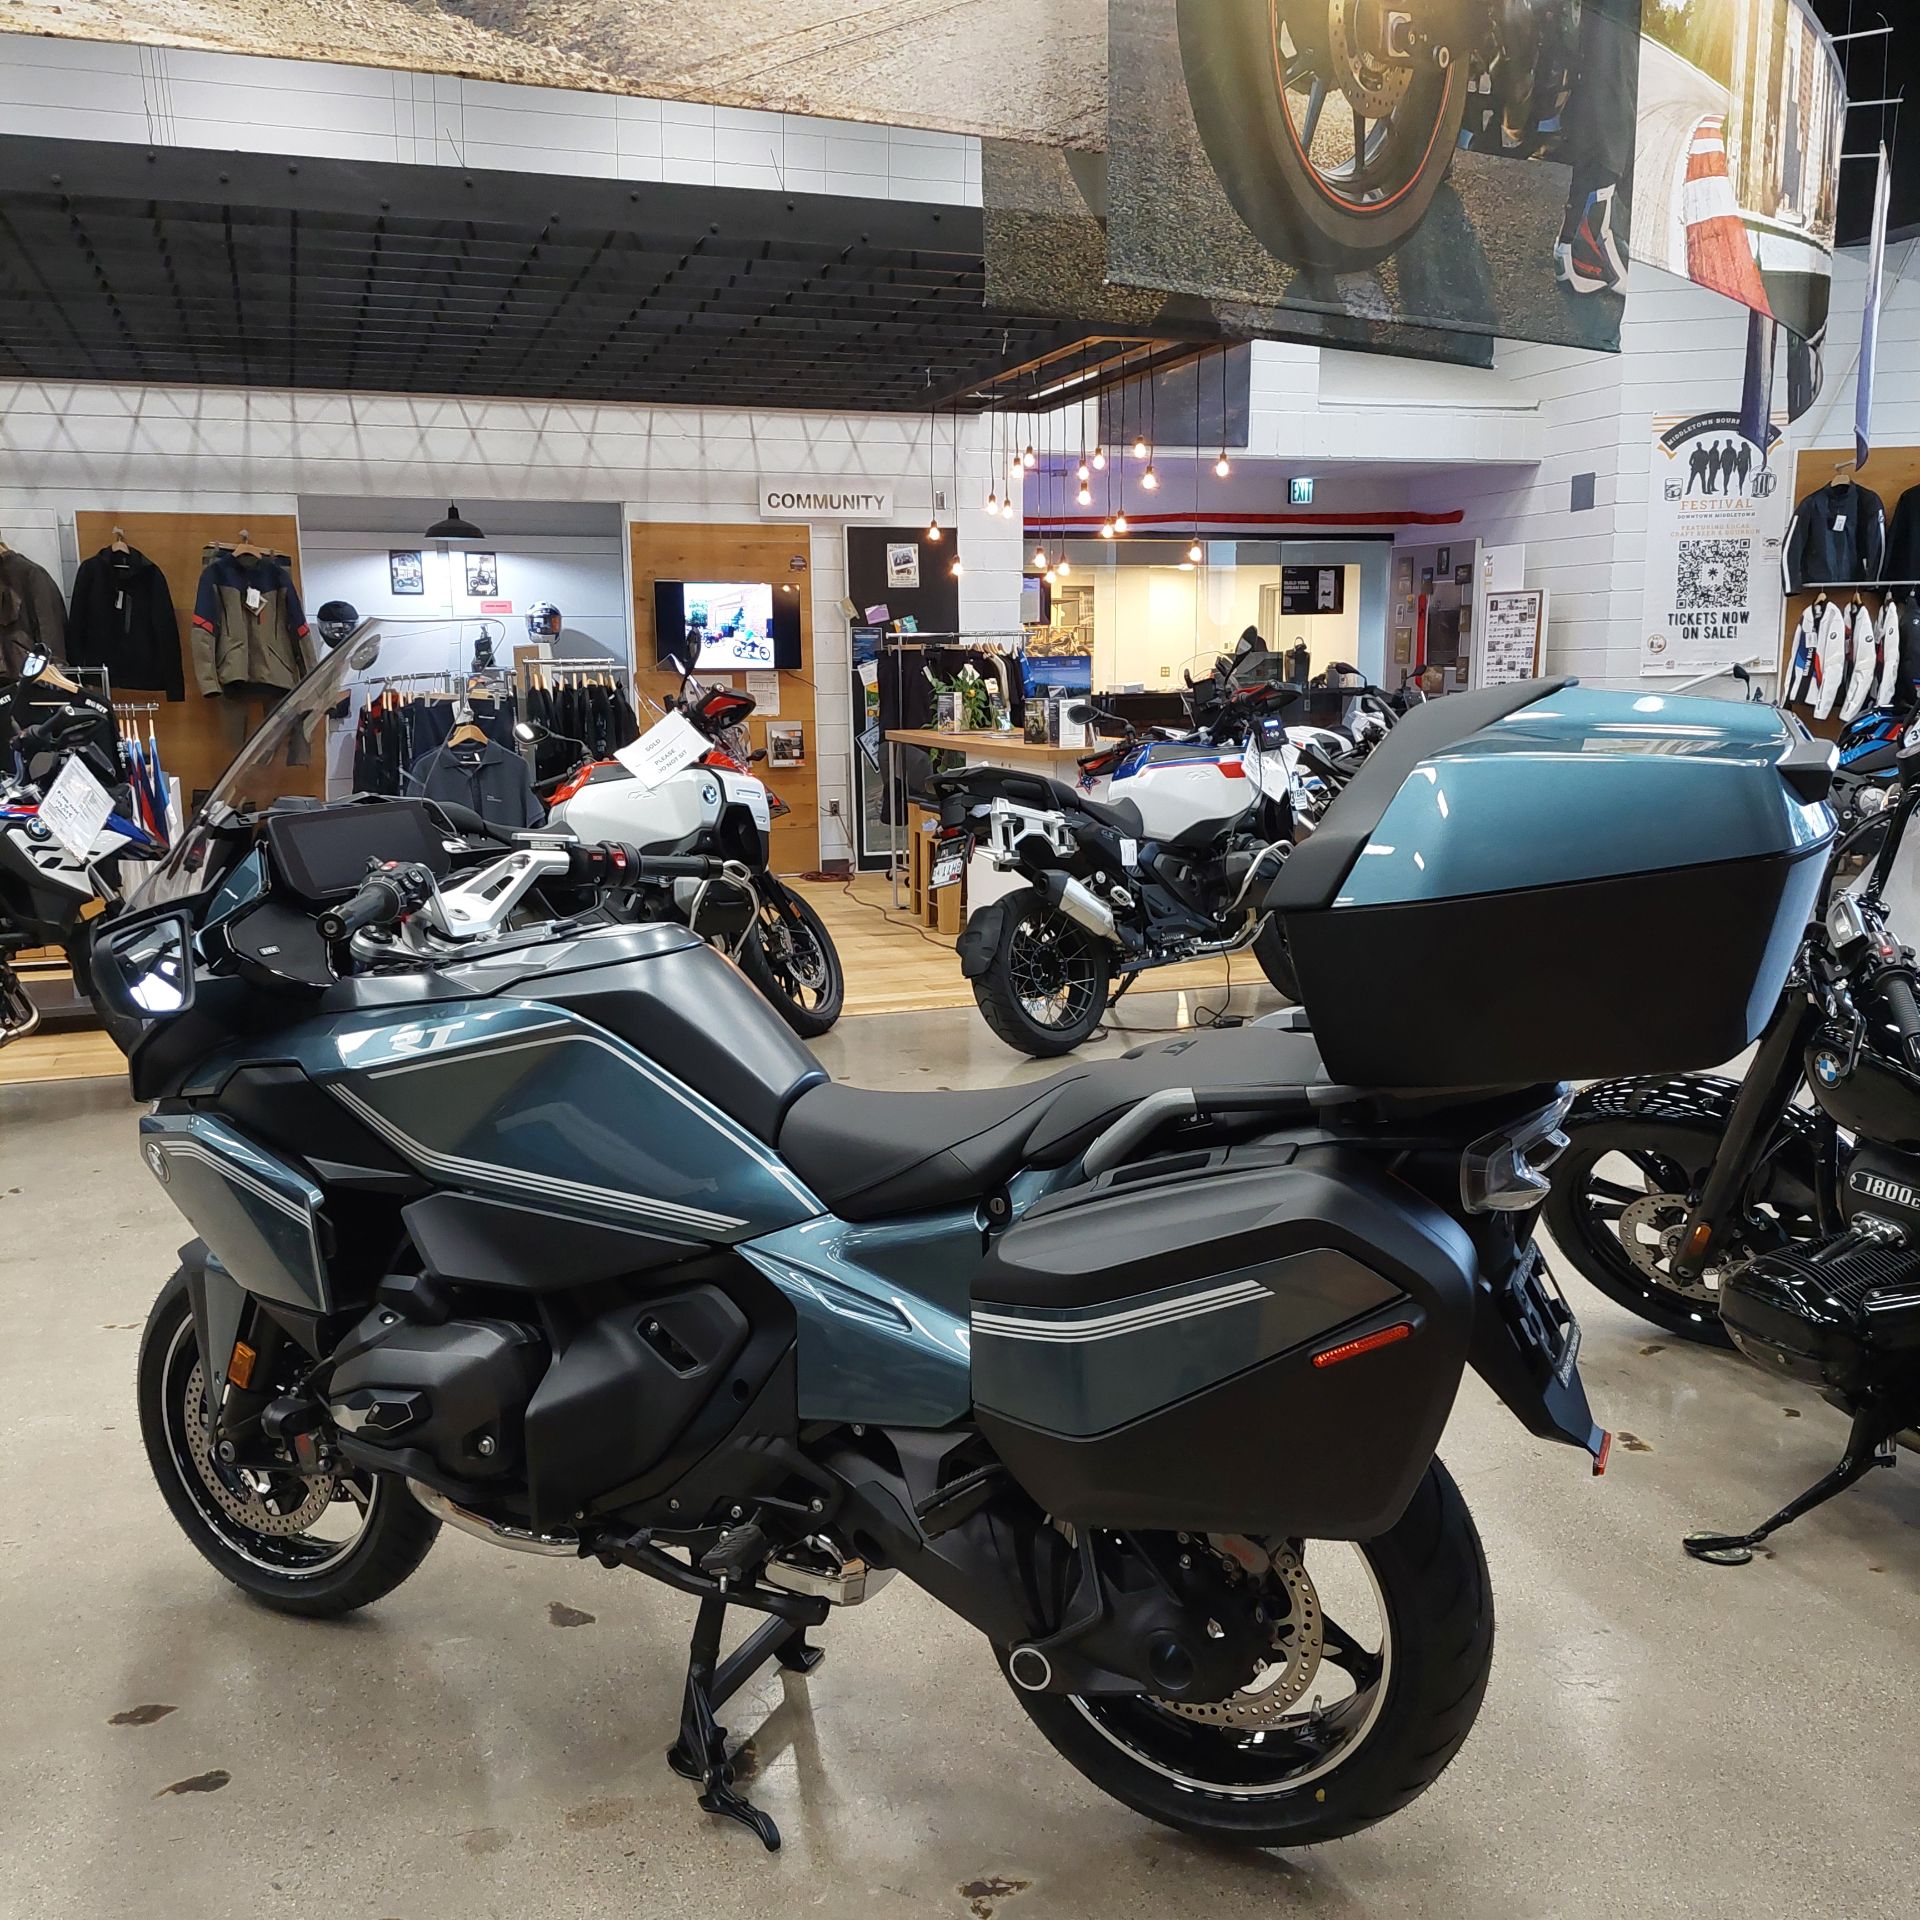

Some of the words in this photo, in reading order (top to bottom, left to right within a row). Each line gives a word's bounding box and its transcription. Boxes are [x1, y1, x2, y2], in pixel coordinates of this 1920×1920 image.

[1666, 418, 1713, 446] MIDDLETOWN
[1292, 480, 1312, 503] EXIT
[767, 492, 885, 511] COMMUNITY
[1680, 498, 1753, 511] FESTIVAL
[1714, 511, 1756, 519] MIDDLETOWN
[1667, 612, 1718, 626] TICKETS
[1722, 611, 1750, 625] NOW
[1682, 626, 1699, 640] ON
[1703, 625, 1738, 639] SALE!
[645, 738, 661, 752] SOLD
[654, 748, 677, 766] PLEASE
[666, 757, 679, 768] NOT
[678, 749, 688, 759] SIT
[389, 1021, 466, 1052] RT
[1864, 1176, 1920, 1208] 1800c
